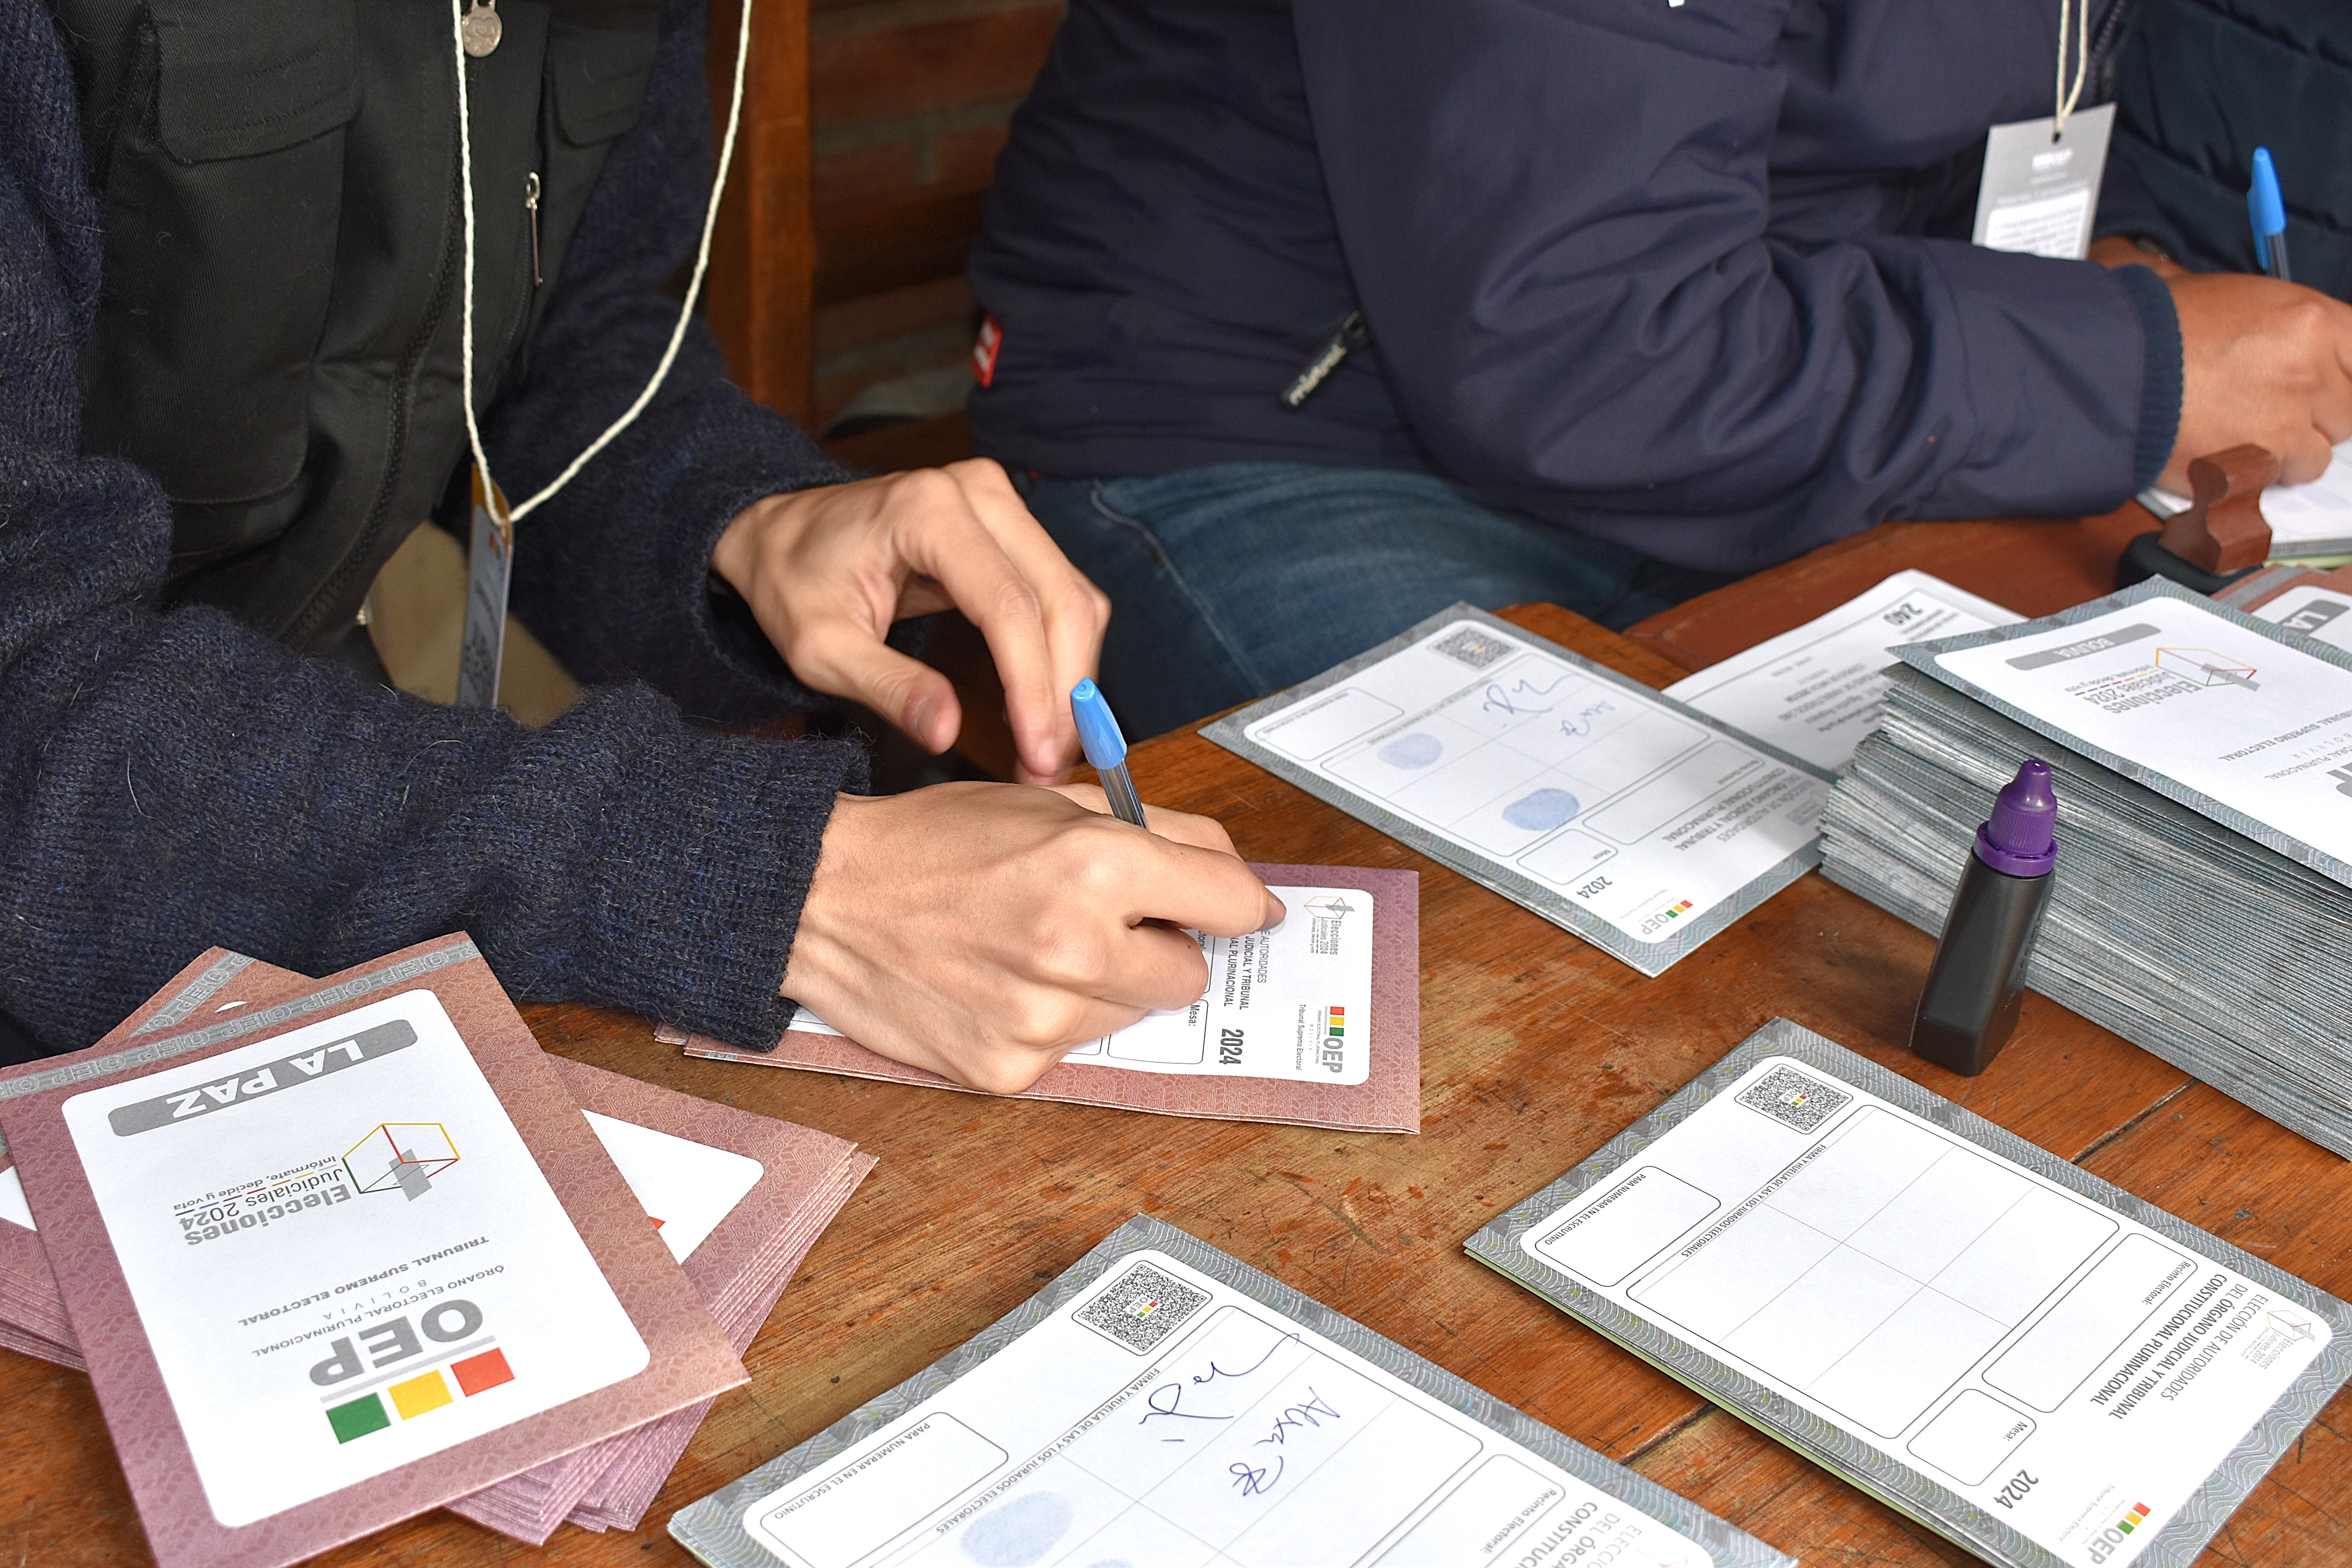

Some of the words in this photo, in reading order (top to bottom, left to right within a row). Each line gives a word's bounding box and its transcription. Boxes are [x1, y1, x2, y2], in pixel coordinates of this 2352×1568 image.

[2084, 688, 2125, 704] 2024
[2103, 681, 2203, 713] Elecciones
[2274, 724, 2320, 743] SUPREMO
[2219, 740, 2276, 761] ELECTORAL
[2264, 755, 2332, 780] PLURINACIONAL
[1577, 877, 1612, 898] 2024
[1641, 913, 1671, 935] OEP
[1320, 941, 1328, 954] 2024
[1330, 920, 1341, 955] Elecciones
[1243, 936, 1254, 966] JUDICIAL
[1257, 936, 1269, 983] AUTORIDADES
[1224, 950, 1238, 1006] PLURINACIONAL
[1240, 975, 1251, 1010] TRIBUNAL
[1189, 1005, 1200, 1026] Mesa:
[287, 1038, 365, 1080] LA
[1219, 1029, 1244, 1064] 2024
[1323, 1038, 1343, 1073] OEP
[165, 1066, 278, 1119] PAZ
[1805, 1145, 1826, 1159] FIRMA
[267, 1156, 336, 1180] Infórmate,
[1627, 1174, 1646, 1186] PARA
[1779, 1163, 1804, 1180] HUELLA
[219, 1180, 263, 1196] decide
[246, 1169, 343, 1206] Judiciales
[1596, 1185, 1630, 1208] NUMERAR
[1761, 1186, 1775, 1195] LAS
[174, 1198, 204, 1210] vota
[185, 1184, 351, 1245] Elecciones
[1746, 1198, 1760, 1207] LOS
[180, 1202, 239, 1230] 2024
[1719, 1206, 1748, 1228] JURADOS
[1545, 1219, 1583, 1245] ESCRUTINIO
[1681, 1227, 1722, 1257] ELECTORALES
[412, 1237, 489, 1266] TRIBUNAL
[335, 1264, 408, 1294] SUPREMO
[448, 1265, 504, 1289] ÓRGANO
[2167, 1261, 2190, 1280] Recinto
[323, 1280, 426, 1319] BOLIVIA
[365, 1286, 444, 1317] ELECTORAL
[2142, 1280, 2171, 1304] Electoral:
[2226, 1284, 2248, 1299] DEL
[238, 1291, 330, 1326] ELECTORAL
[1129, 1297, 1149, 1313] OEP
[2155, 1274, 2227, 1339] CONSTITUCIONAL
[2193, 1299, 2234, 1334] ÓRGANO
[2226, 1294, 2268, 1332] ELECCIÓN
[252, 1315, 362, 1356] PLURINACIONAL
[310, 1299, 483, 1386] OEP
[2214, 1330, 2233, 1345] DE
[2260, 1332, 2281, 1351] Judiciales
[2157, 1332, 2199, 1370] JUDICIAL
[2250, 1350, 2265, 1363] 2024
[2259, 1338, 2293, 1369] Elecciones
[1130, 1368, 1160, 1390] FIRMA
[2090, 1339, 2163, 1405] PLURINACIONAL
[2152, 1370, 2165, 1378] Y
[2161, 1341, 2221, 1400] AUTORIDADES
[1091, 1396, 1125, 1420] HUELLA
[2109, 1376, 2158, 1419] TRIBUNAL
[904, 1423, 930, 1439] PARA
[1062, 1430, 1080, 1443] LAS
[1079, 1421, 1093, 1431] DE
[2004, 1422, 2027, 1441] Mesa:
[857, 1439, 905, 1469] NUMERAR
[1038, 1448, 1056, 1461] LOS
[843, 1468, 858, 1478] EN
[996, 1460, 1038, 1491] JURADOS
[775, 1485, 831, 1519] ESCRUTINIO
[1522, 1488, 1557, 1516] Recinto
[1994, 1470, 2038, 1509] 2024
[2095, 1485, 2114, 1502] Tribunal
[936, 1490, 997, 1533] ELECTORALES
[1589, 1513, 1621, 1534] DEL
[2076, 1502, 2098, 1521] Supremo
[1481, 1517, 1524, 1553] Electoral:
[2059, 1521, 2079, 1542] Electoral
[2087, 1528, 2123, 1564] OEP
